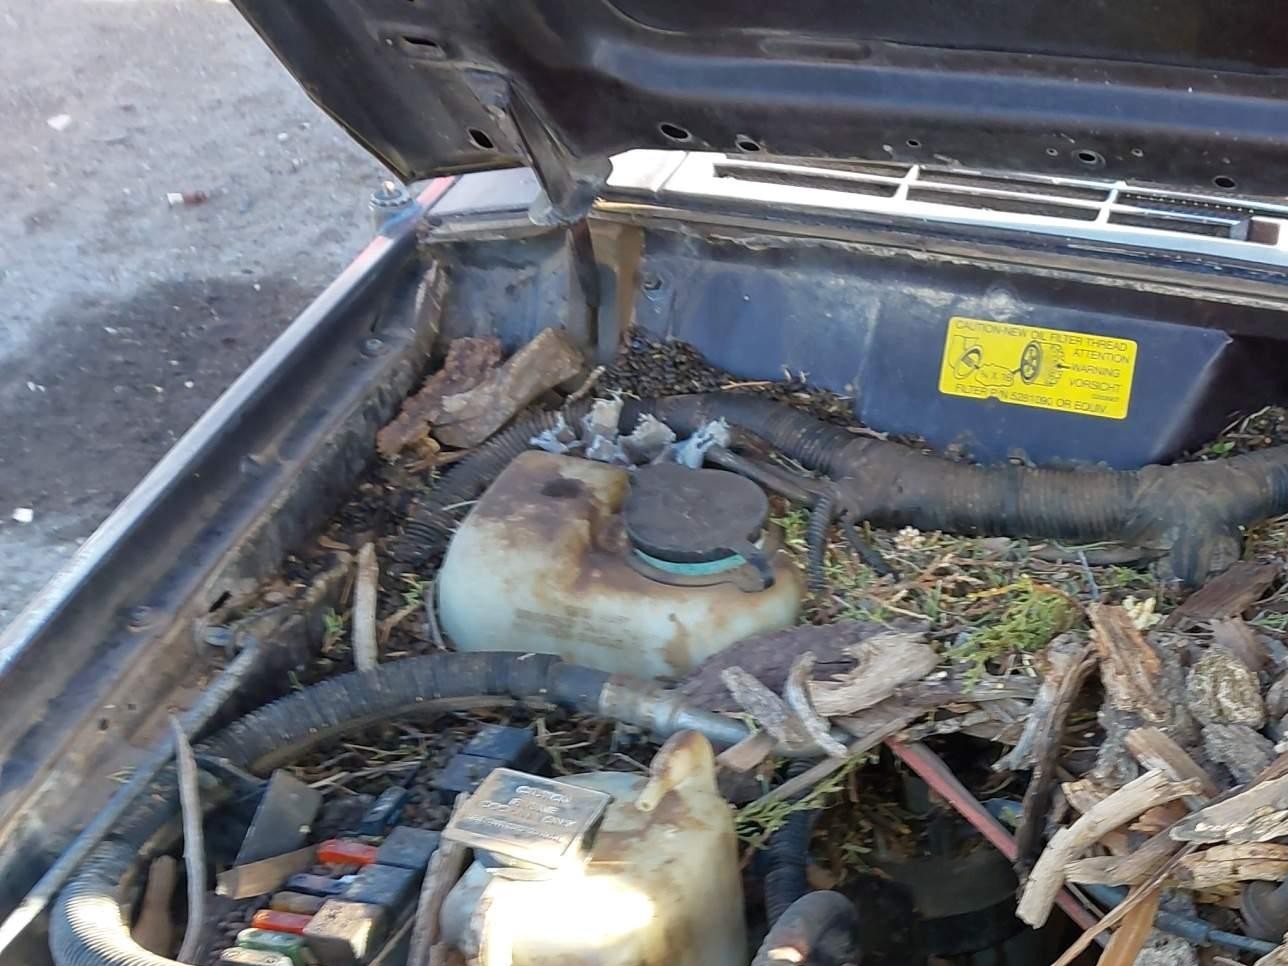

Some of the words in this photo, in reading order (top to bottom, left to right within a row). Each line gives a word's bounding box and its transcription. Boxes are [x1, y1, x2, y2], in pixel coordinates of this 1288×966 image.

[1031, 330, 1046, 341] OIL
[1050, 333, 1082, 345] FILTER
[1087, 337, 1127, 352] THREAD
[1073, 348, 1129, 363] ATTENTION
[1071, 364, 1120, 378] WARNING
[1070, 378, 1121, 392] VORSICHT
[955, 384, 987, 396] FILTER
[1056, 398, 1071, 408] OR
